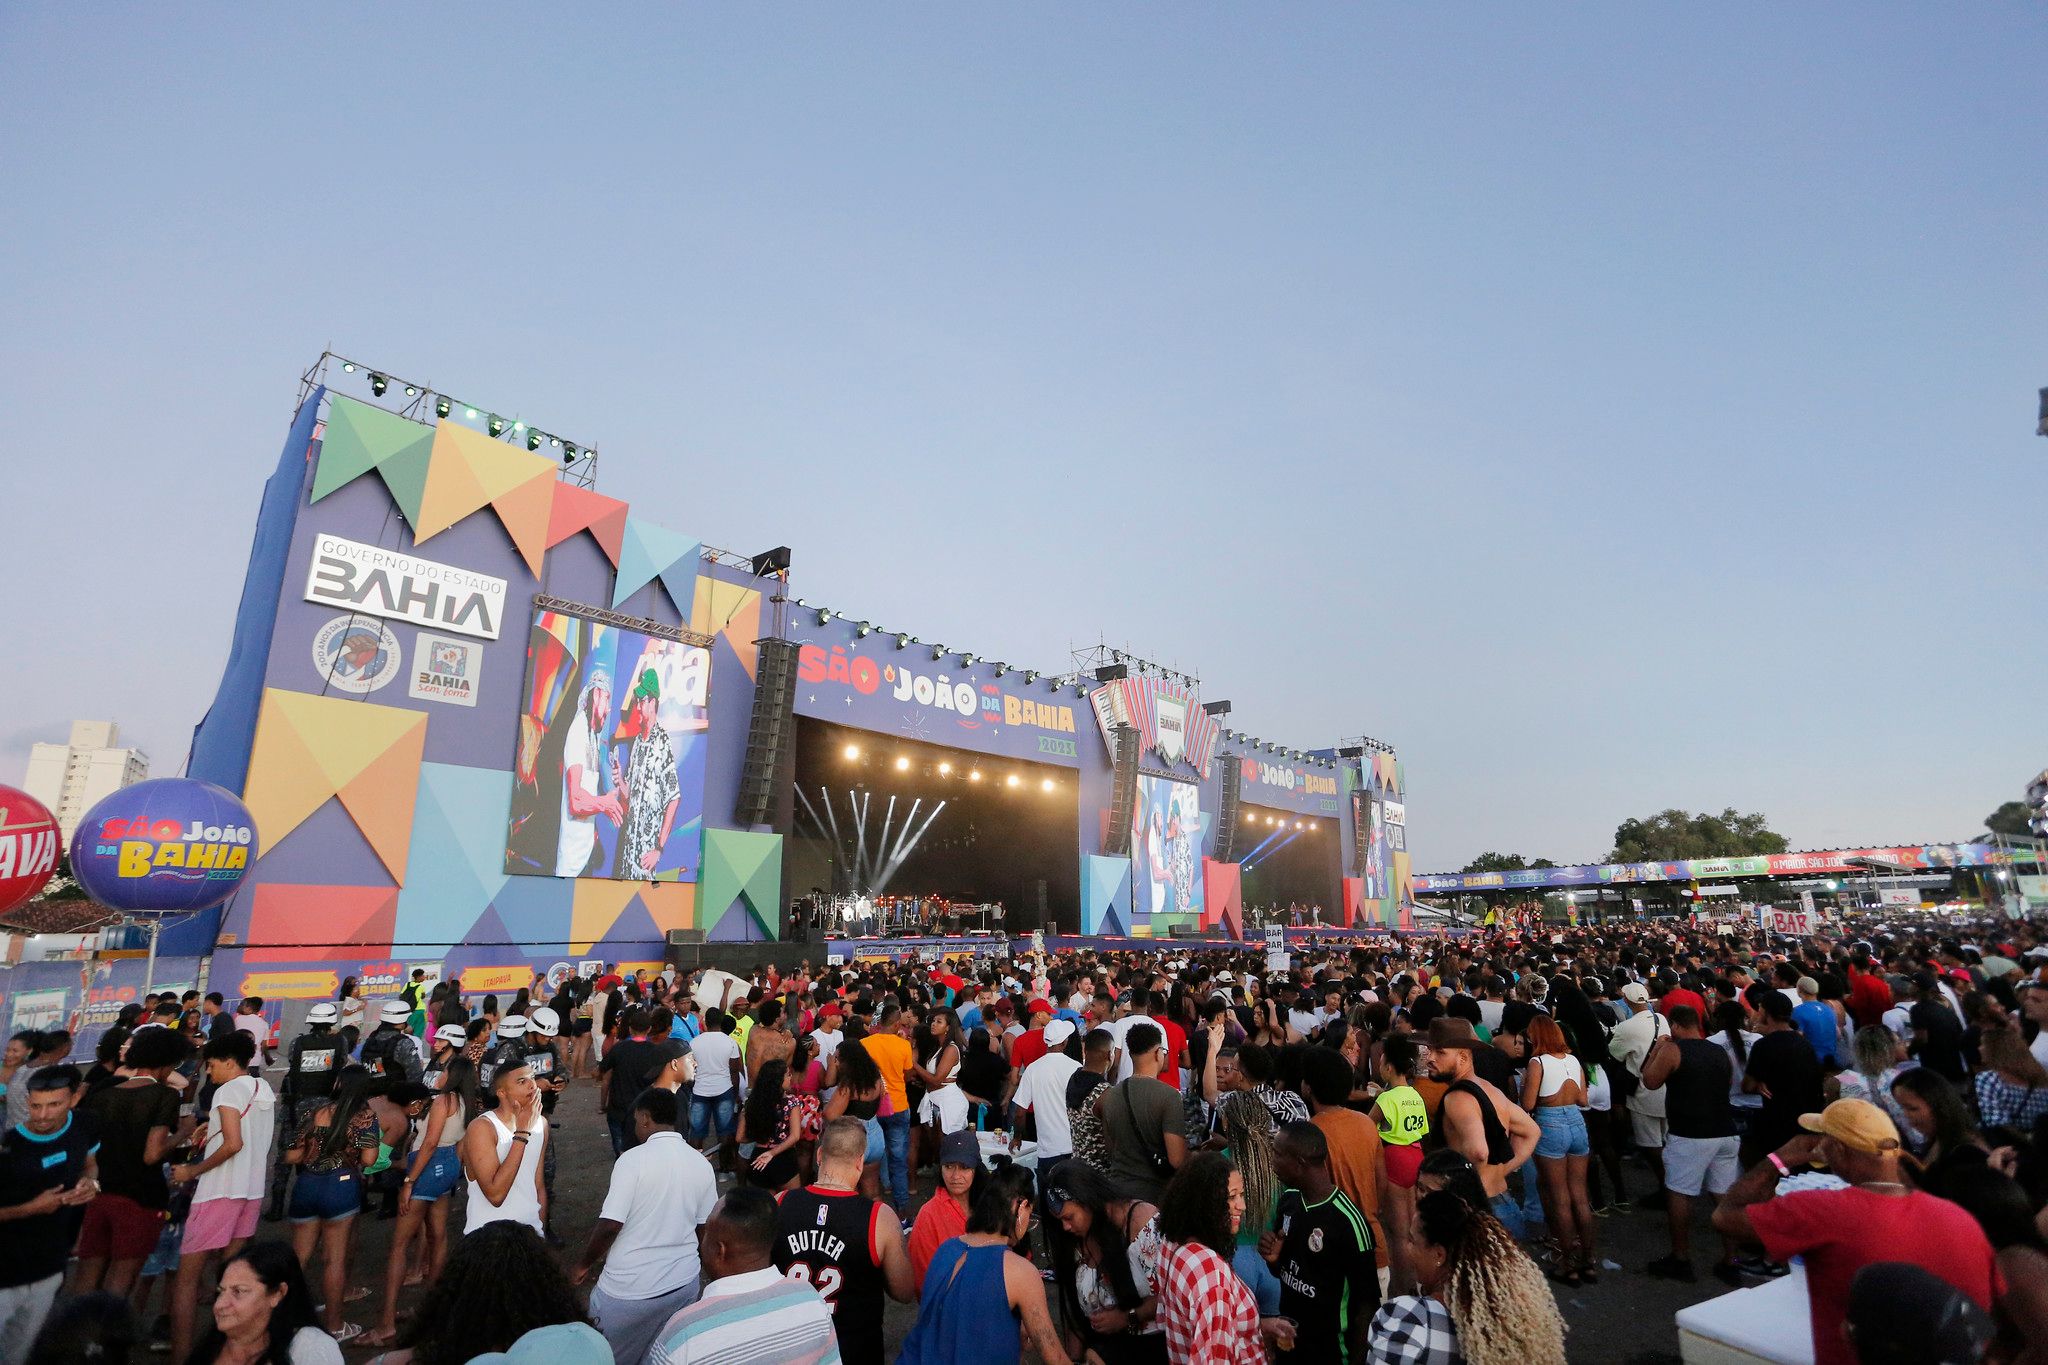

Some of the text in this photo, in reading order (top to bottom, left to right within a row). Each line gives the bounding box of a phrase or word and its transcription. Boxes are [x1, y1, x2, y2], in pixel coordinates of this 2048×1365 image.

[322, 540, 501, 594] GOVERNO DO ESTADO
[313, 555, 493, 632] BAHIA
[419, 672, 470, 691] BAHIA
[797, 644, 1076, 733] SÃO JOÃO DA BAHIA
[1262, 762, 1295, 790] JOÃO
[1305, 774, 1337, 795] BAHIA
[101, 816, 251, 844] SÃO JOÃO
[96, 845, 117, 856] DA
[118, 841, 248, 878] BAHIA
[1779, 858, 1806, 869] MAIOR
[1809, 857, 1824, 868] SÃO
[1428, 878, 1458, 889] JOÃO
[1463, 875, 1504, 887] BAHIA
[1774, 912, 1810, 934] BAR
[1266, 929, 1282, 937] BAR
[1266, 941, 1282, 949] BAR
[363, 962, 402, 976] SÃO
[360, 974, 394, 985] JOÃO
[483, 974, 511, 987] ITAIPAVA
[359, 983, 400, 996] BAHIA
[1404, 1115, 1424, 1131] 028
[787, 1229, 846, 1262] BUTLER
